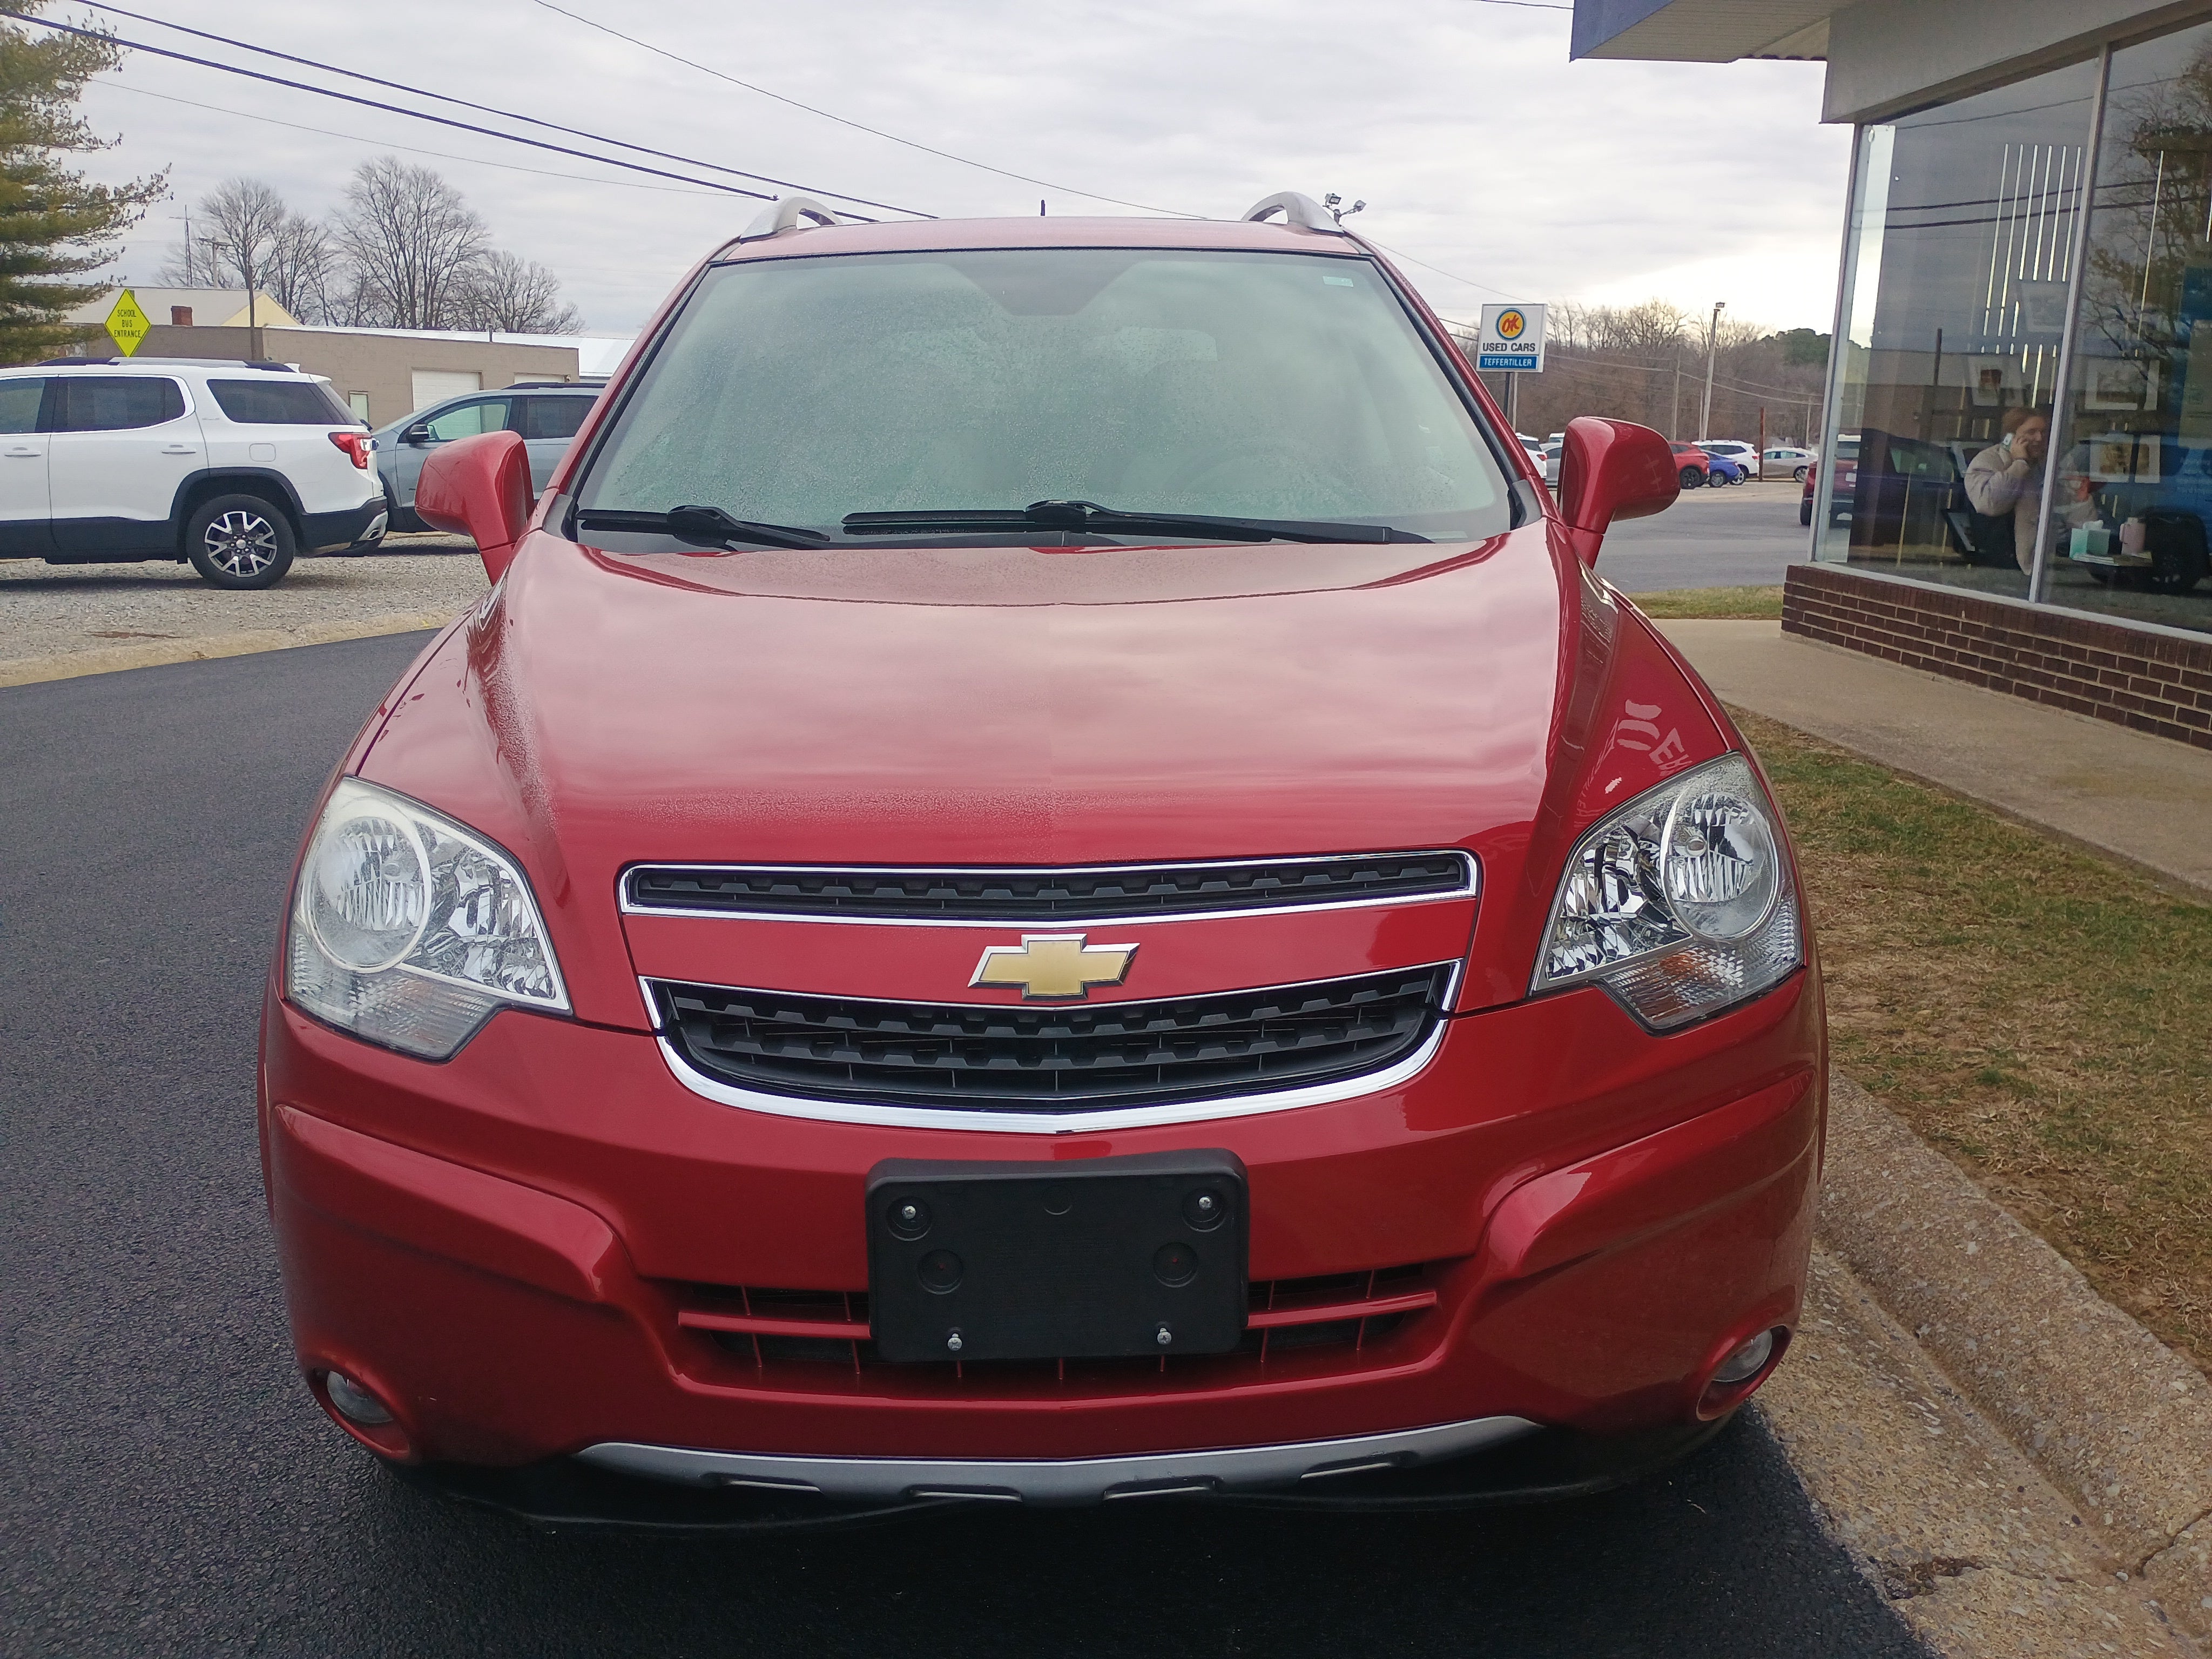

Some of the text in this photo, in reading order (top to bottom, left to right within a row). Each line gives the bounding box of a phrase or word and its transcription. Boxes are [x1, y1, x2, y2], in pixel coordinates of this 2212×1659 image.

[1502, 315, 1519, 333] OK
[1482, 343, 1535, 352] USED CARS
[1484, 358, 1532, 366] TEFFERTILLER
